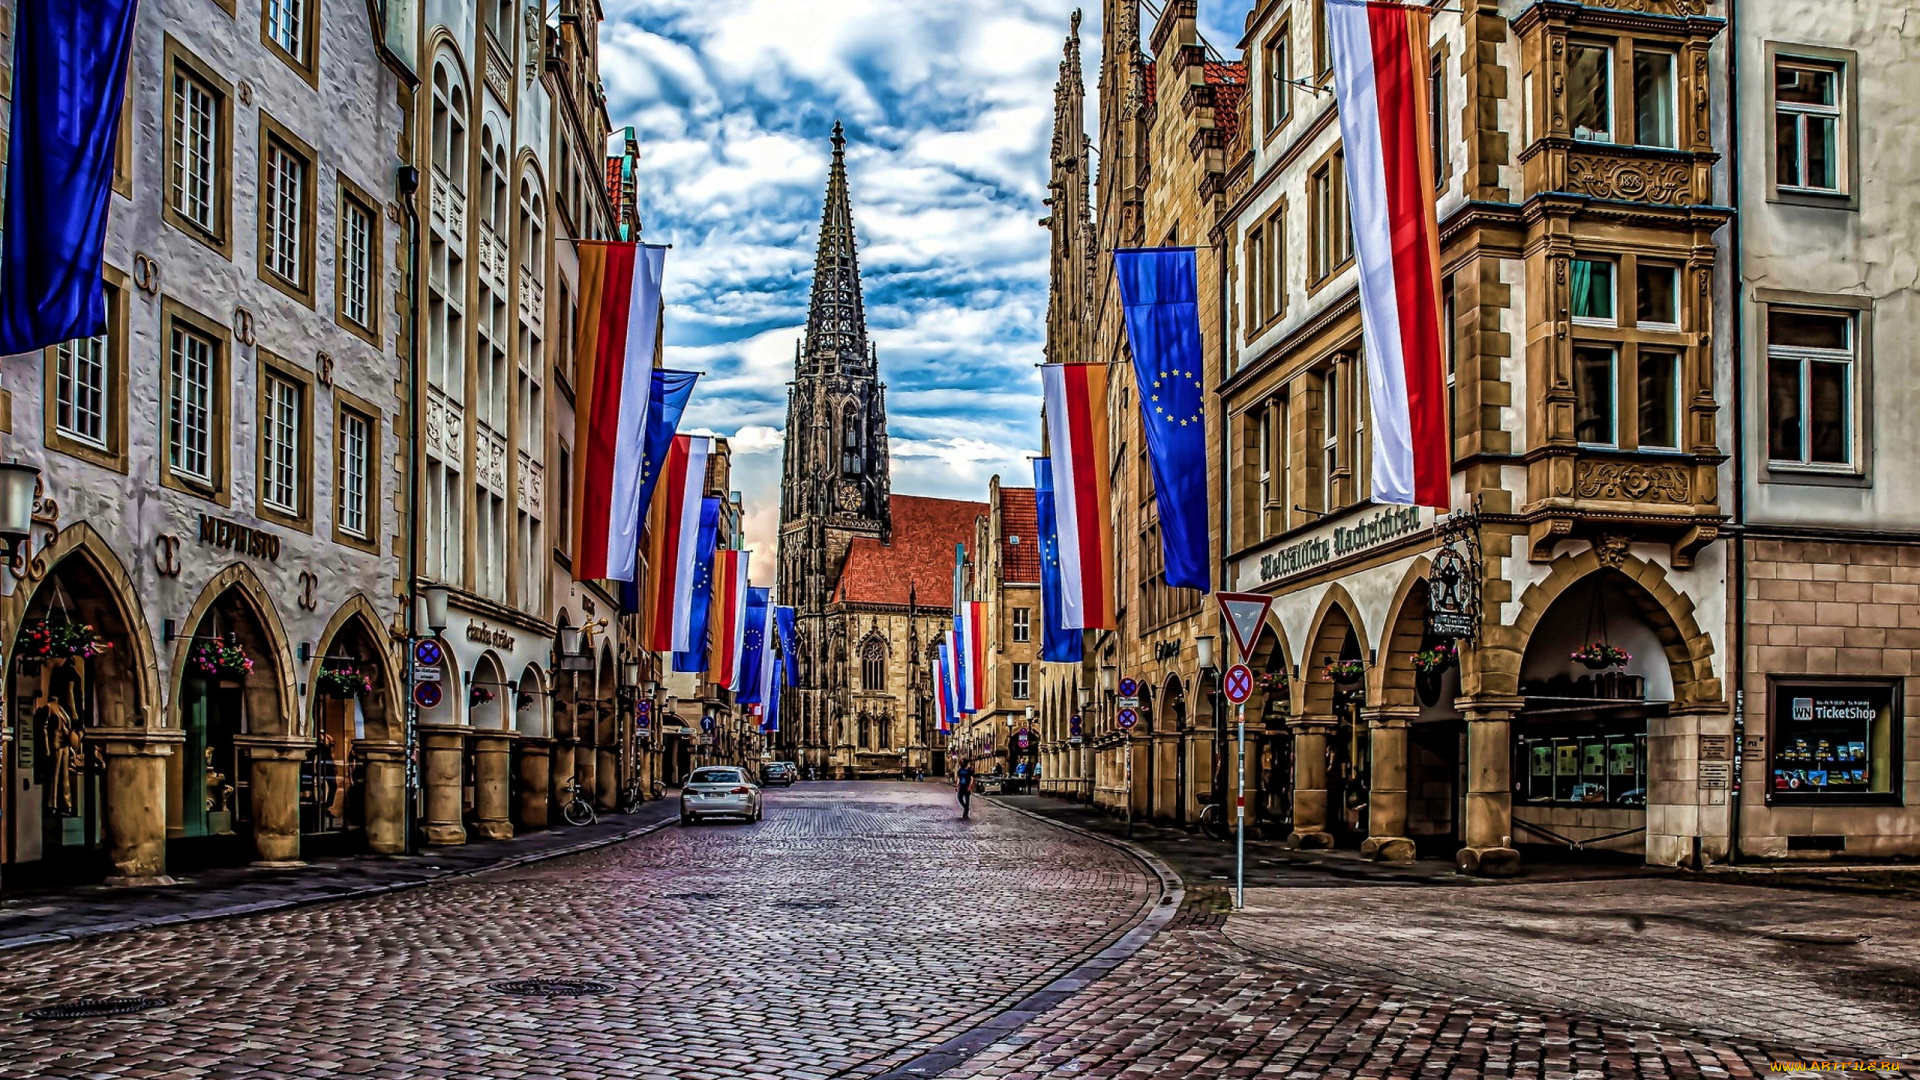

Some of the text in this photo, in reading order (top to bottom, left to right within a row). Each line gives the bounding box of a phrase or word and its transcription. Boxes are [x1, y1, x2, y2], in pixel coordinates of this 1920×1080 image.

[1620, 174, 1641, 188] 1898
[198, 513, 281, 562] MEPHISTO
[1334, 505, 1421, 556] Nachrichten
[1794, 706, 1812, 718] WN
[1815, 705, 1876, 721] TicketShop
